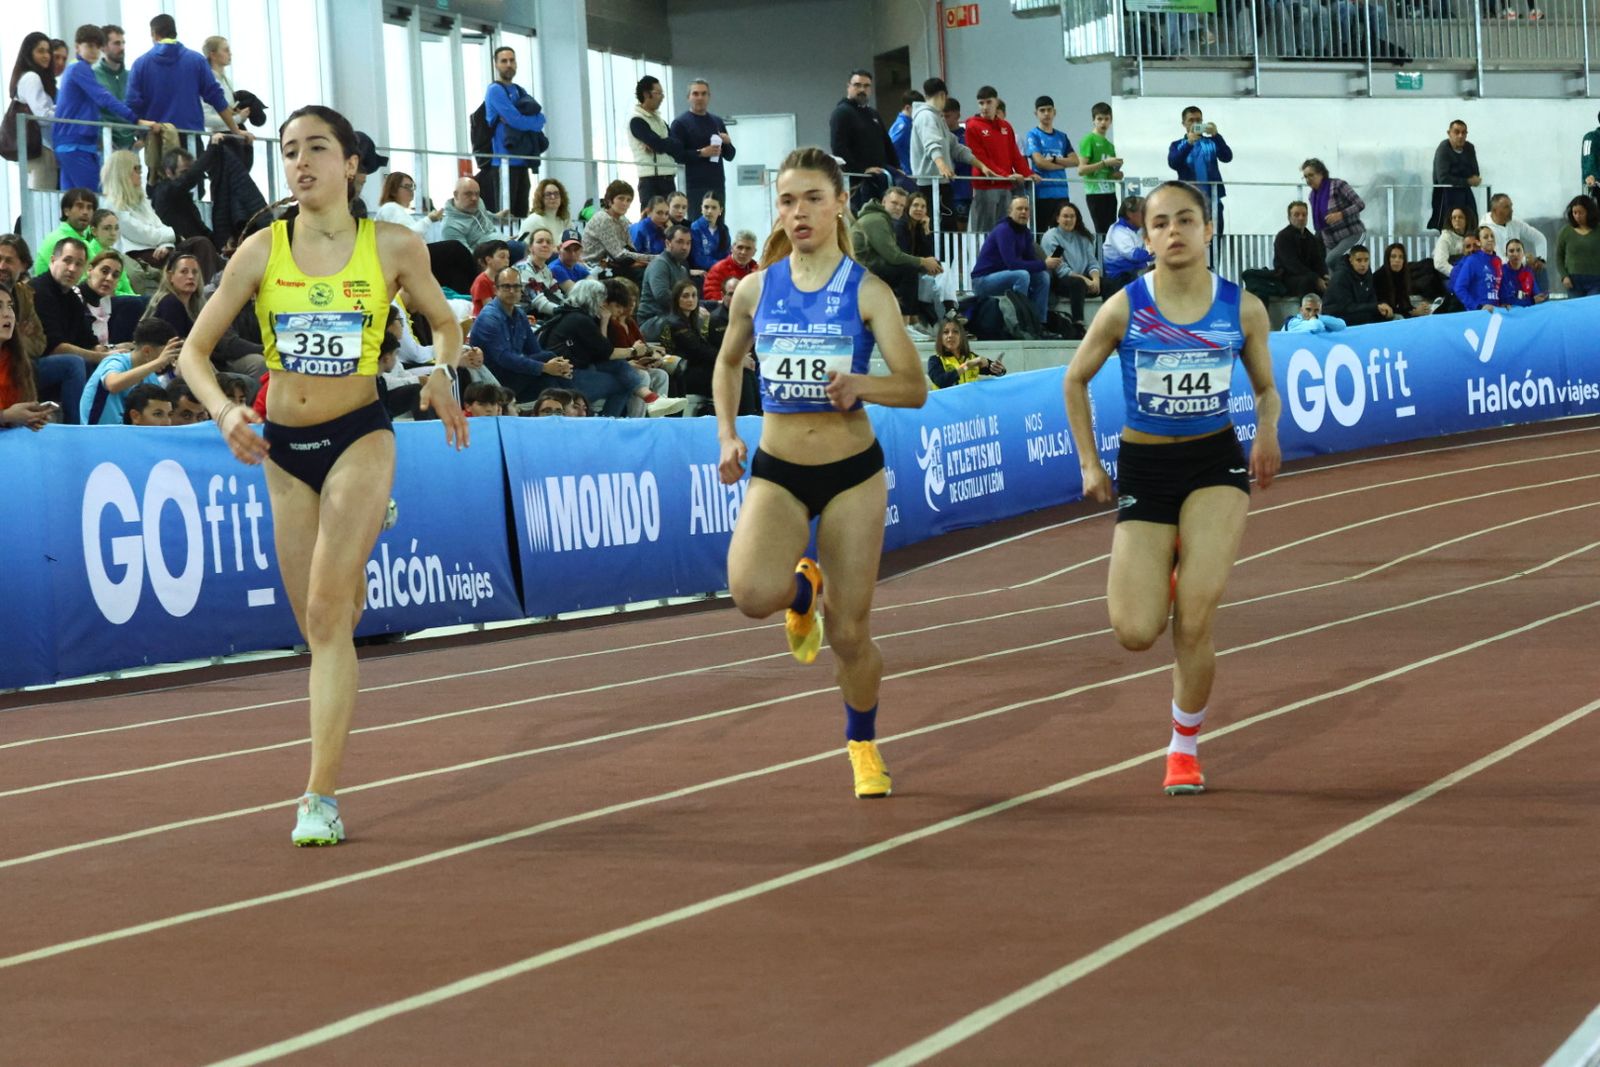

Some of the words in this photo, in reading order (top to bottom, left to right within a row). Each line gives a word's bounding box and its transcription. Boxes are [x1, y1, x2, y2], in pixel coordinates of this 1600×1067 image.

[765, 323, 842, 334] SOLISS
[293, 333, 344, 357] 336
[777, 358, 827, 380] 418
[780, 384, 828, 399] Jom
[1162, 373, 1212, 395] 144
[1467, 369, 1555, 415] Halcón
[1557, 379, 1600, 405] viajes
[943, 414, 987, 447] FEDERACIÓN
[988, 414, 999, 436] DE
[1025, 412, 1043, 433] NOS
[1101, 431, 1122, 452] Junt
[946, 441, 1002, 477] ATLETISMO
[545, 471, 660, 552] MONDO
[363, 538, 446, 610] alcón
[446, 562, 494, 608] viajes
